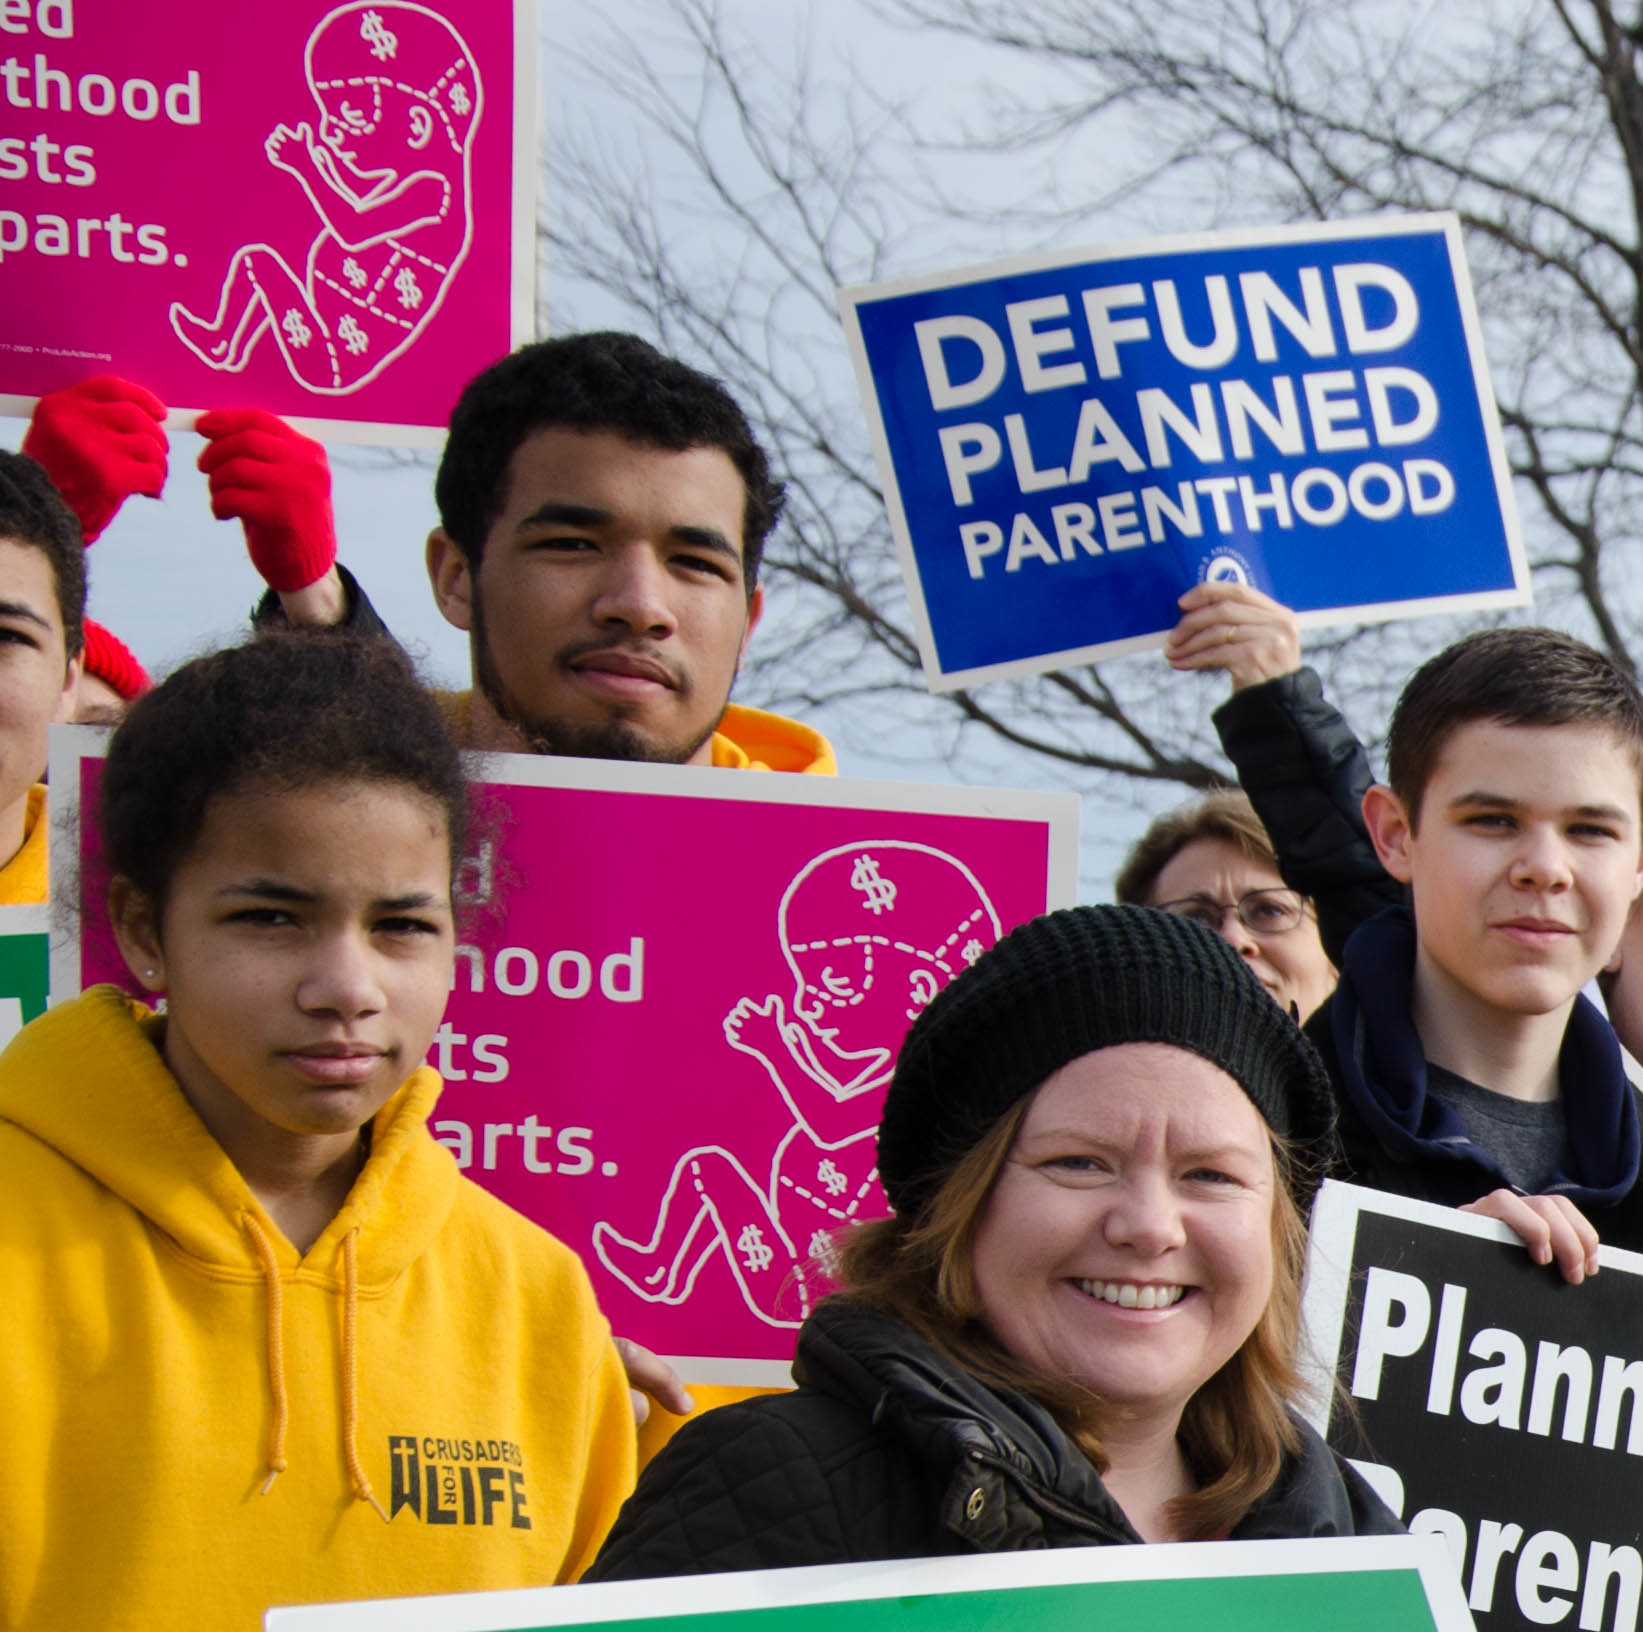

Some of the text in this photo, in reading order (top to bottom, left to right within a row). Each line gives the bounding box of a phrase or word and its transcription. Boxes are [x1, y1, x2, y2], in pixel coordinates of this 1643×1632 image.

[0, 54, 200, 125] thood
[0, 133, 97, 187] sts
[0, 210, 188, 268] parts.
[914, 263, 1419, 412] DEFUND
[938, 366, 1438, 507] PLANNED
[959, 459, 1456, 580] PARENTHOOD
[423, 1437, 523, 1467] CRUSADERS
[425, 1465, 532, 1530] LIFE
[442, 1466, 456, 1505] FOR
